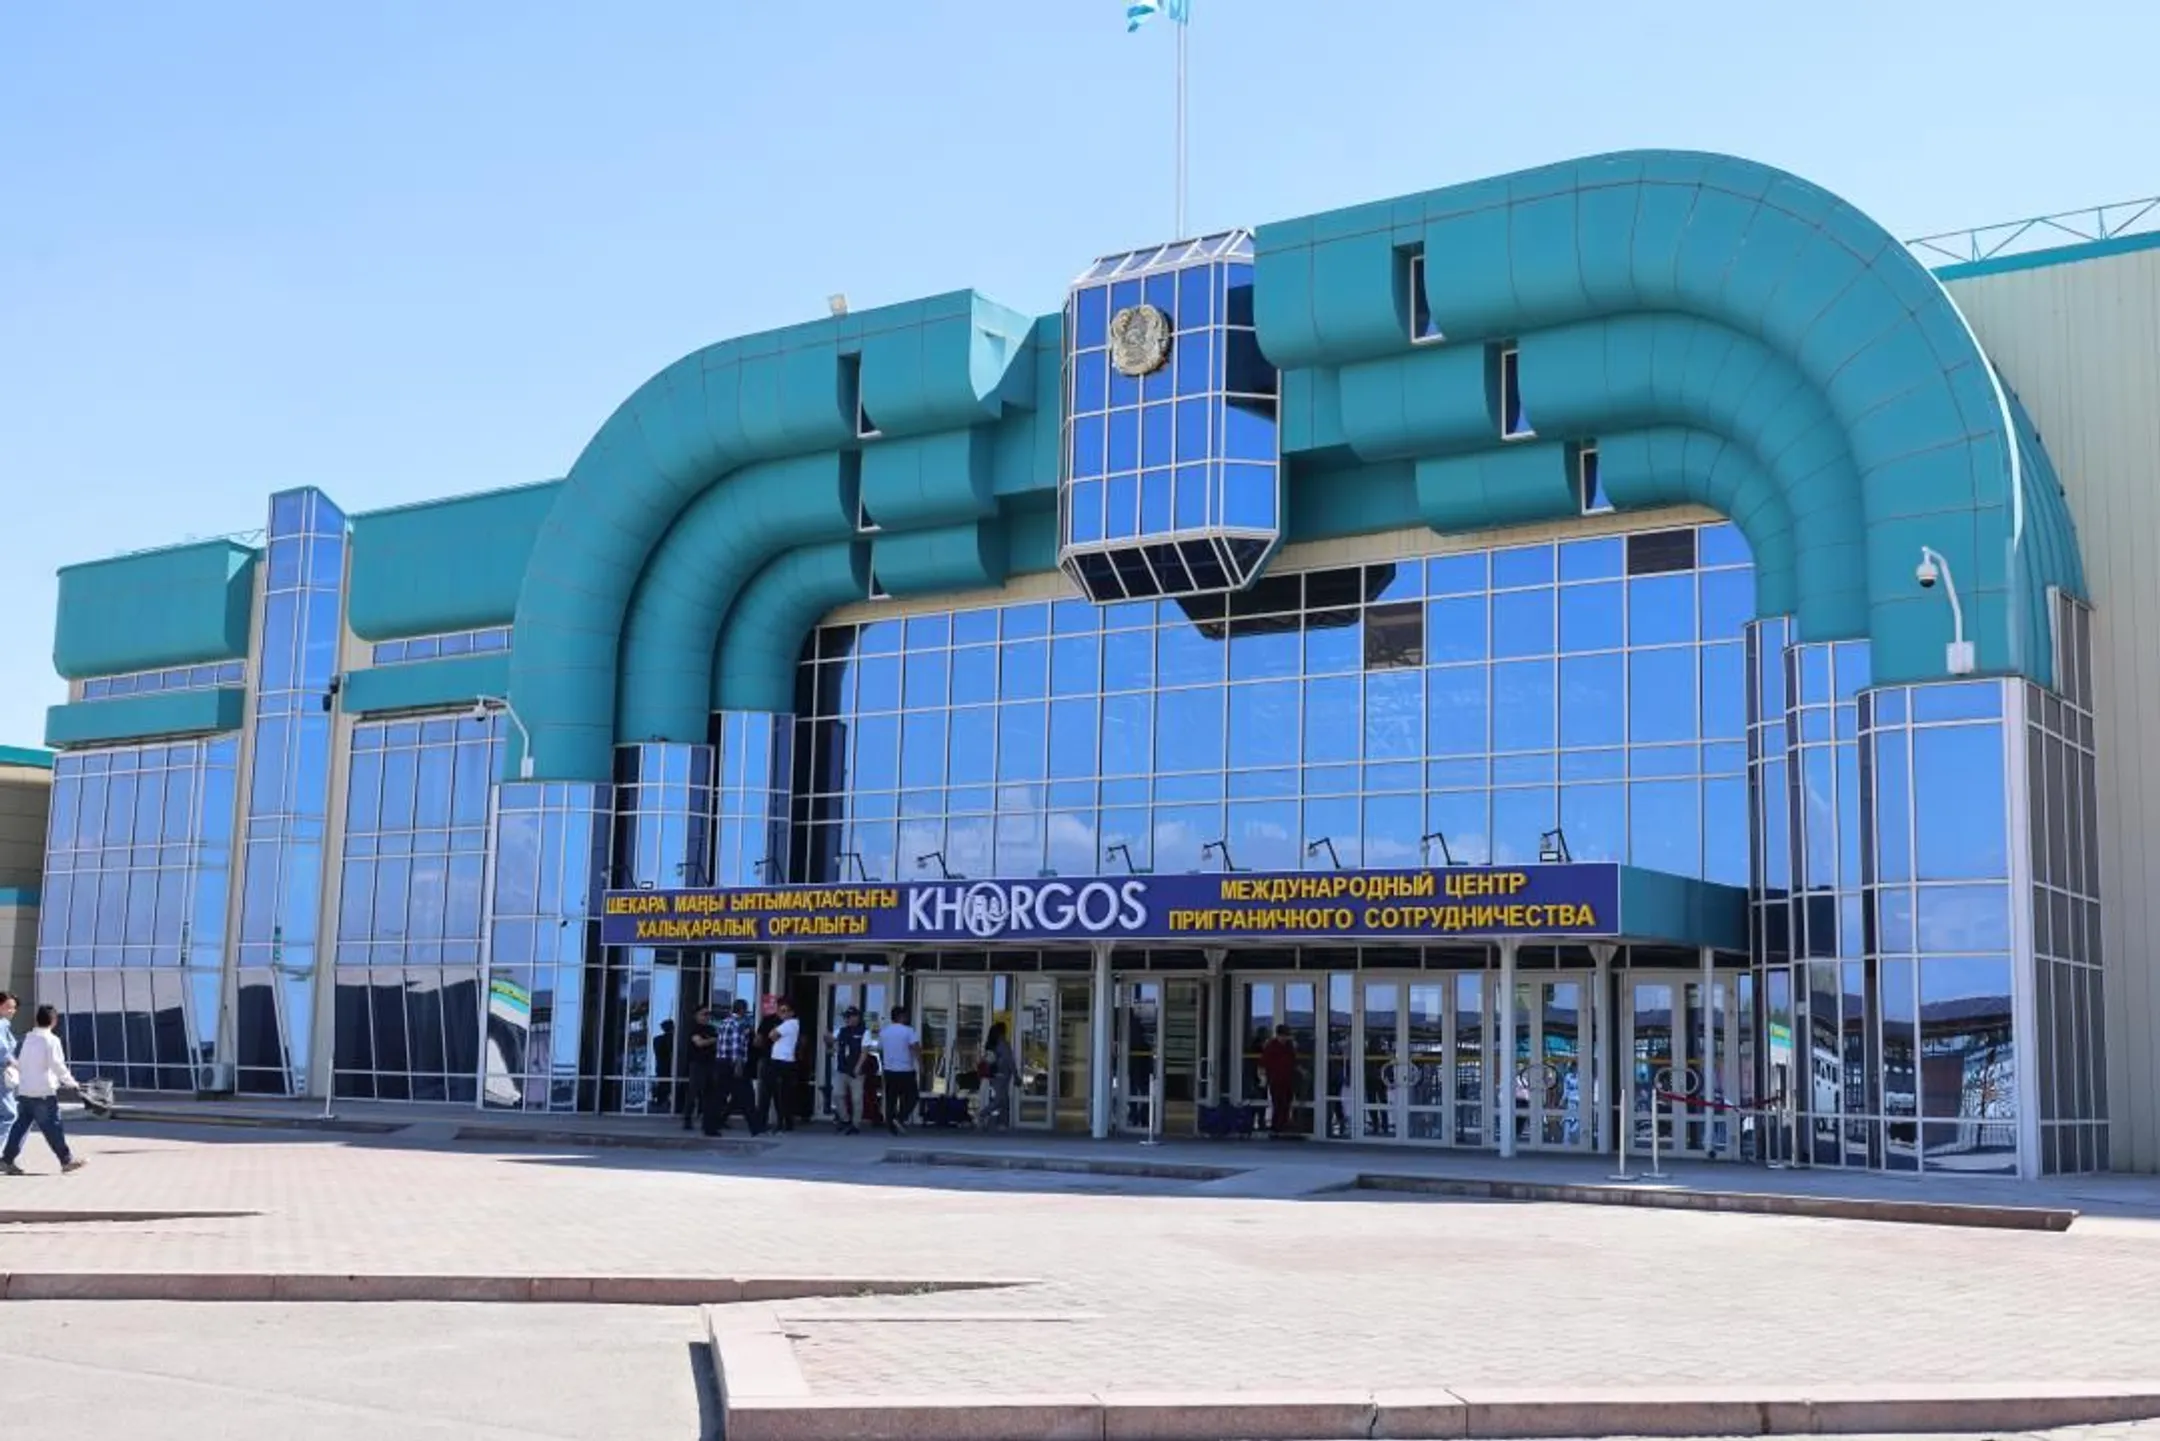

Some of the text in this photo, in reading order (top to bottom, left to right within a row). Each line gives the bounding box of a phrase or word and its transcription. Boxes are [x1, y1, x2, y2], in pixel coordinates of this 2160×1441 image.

[1220, 872, 1527, 902] МЕЖДУНАРОДНЫЙ ЦЕНТР
[606, 896, 667, 914] ШЕКАРА
[908, 881, 1148, 937] KHORGOS
[1168, 904, 1596, 931] ПРИГРАНИЧНОГО СОТРУДНИЧЕСТВА
